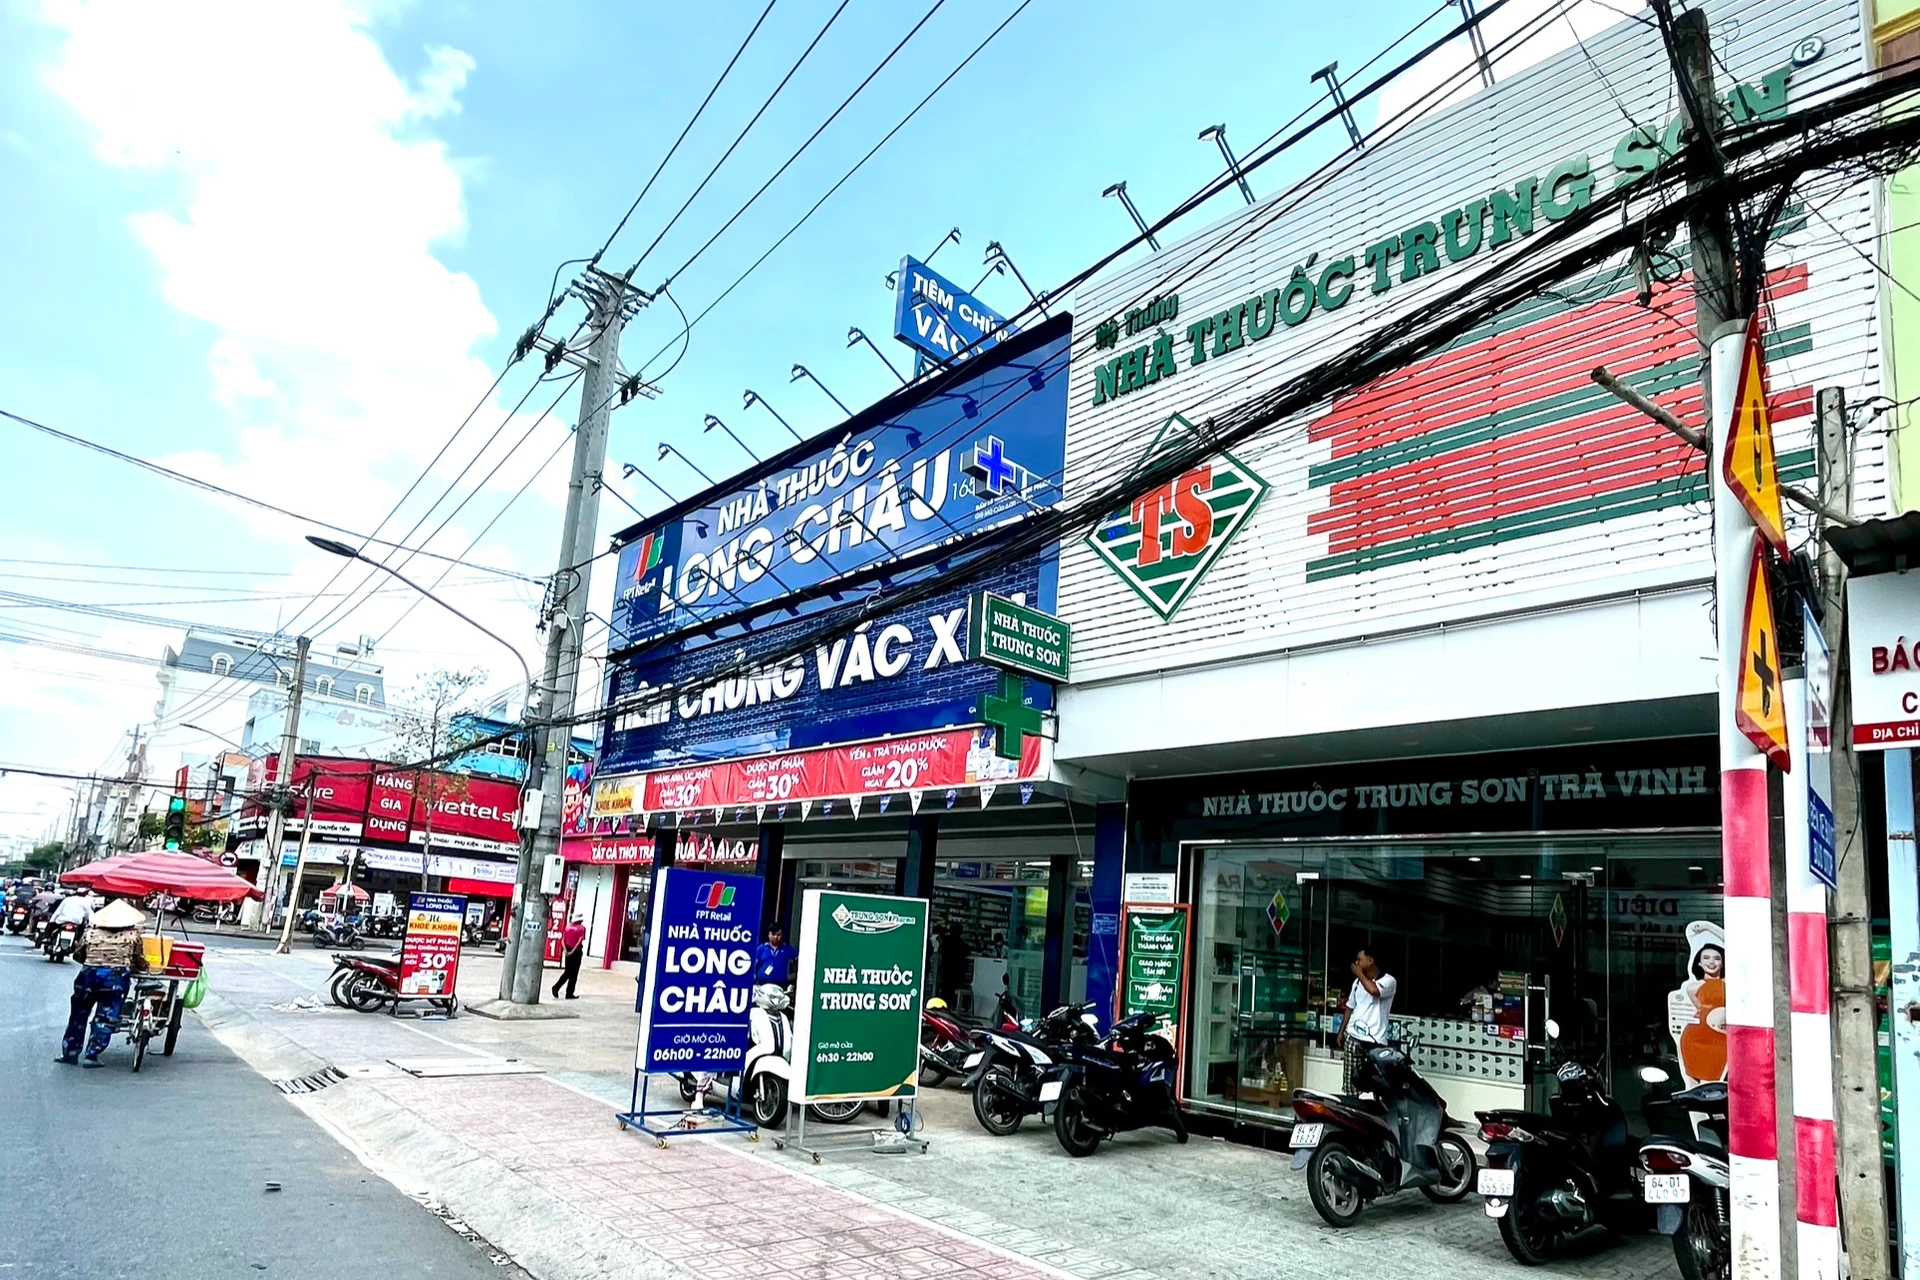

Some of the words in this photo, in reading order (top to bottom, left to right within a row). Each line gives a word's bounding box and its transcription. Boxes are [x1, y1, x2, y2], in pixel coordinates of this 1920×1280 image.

[1092, 327, 1177, 406] NHÀ
[1186, 252, 1355, 366] THUỐC
[1365, 154, 1596, 295] TRUNG
[1613, 64, 1792, 188] SN
[912, 272, 954, 312] TIÊM
[717, 478, 771, 536] NHÀ
[776, 432, 876, 510] THUỐC
[1132, 464, 1213, 566] TS
[659, 527, 775, 614] LONG
[788, 449, 951, 564] CHÂU
[623, 586, 636, 600] FPT
[994, 611, 1019, 632] NHÀ
[1021, 624, 1061, 647] THUỐC
[991, 631, 1034, 659] TRUNG
[1036, 645, 1061, 668] SON
[677, 647, 806, 720] CHỦNG
[815, 618, 914, 690] VẮC
[1873, 727, 1894, 742] ĐỊA
[1897, 721, 1919, 738] CHỈ
[849, 746, 866, 761] YẾN
[872, 743, 891, 758] TRÀ
[891, 740, 918, 756] THẢO
[918, 736, 948, 753] DƯỢC
[376, 773, 413, 791] HÀNG
[861, 763, 885, 778] GIẢM
[884, 756, 928, 789] 20%
[765, 772, 799, 800] 30%
[864, 778, 884, 789] NGAY
[1202, 789, 1252, 817] NHÀ
[1257, 781, 1348, 814] THUỐC
[1355, 779, 1453, 809] TRUNG
[1460, 776, 1530, 806] SON
[1539, 765, 1606, 801] TRÀ
[1615, 765, 1707, 796] VINH
[380, 797, 402, 811] GIA
[369, 818, 407, 833] DỤNG
[592, 842, 606, 861] TẤT
[606, 843, 617, 860] CẢ
[618, 843, 637, 860] THỜI
[553, 919, 559, 930] 2
[696, 910, 710, 920] FPT
[710, 911, 731, 922] Retail
[850, 911, 874, 921] TRUNG
[668, 923, 700, 940] NHÀ
[703, 924, 752, 943] THUỐC
[549, 939, 556, 957] 1
[418, 952, 455, 970] 30%
[665, 946, 752, 976] LONG
[823, 964, 858, 985] NHÀ
[659, 979, 749, 1014] CHÂU
[820, 992, 876, 1011] TRUNG
[878, 992, 912, 1011] SON
[674, 1033, 690, 1044] GIỜ
[691, 1032, 707, 1044] MỞ
[708, 1031, 726, 1044] CỬA
[653, 1048, 694, 1061] 06h00
[703, 1047, 742, 1060] 22h00
[816, 1052, 840, 1063] 6h30
[846, 1051, 874, 1062] 22h00
